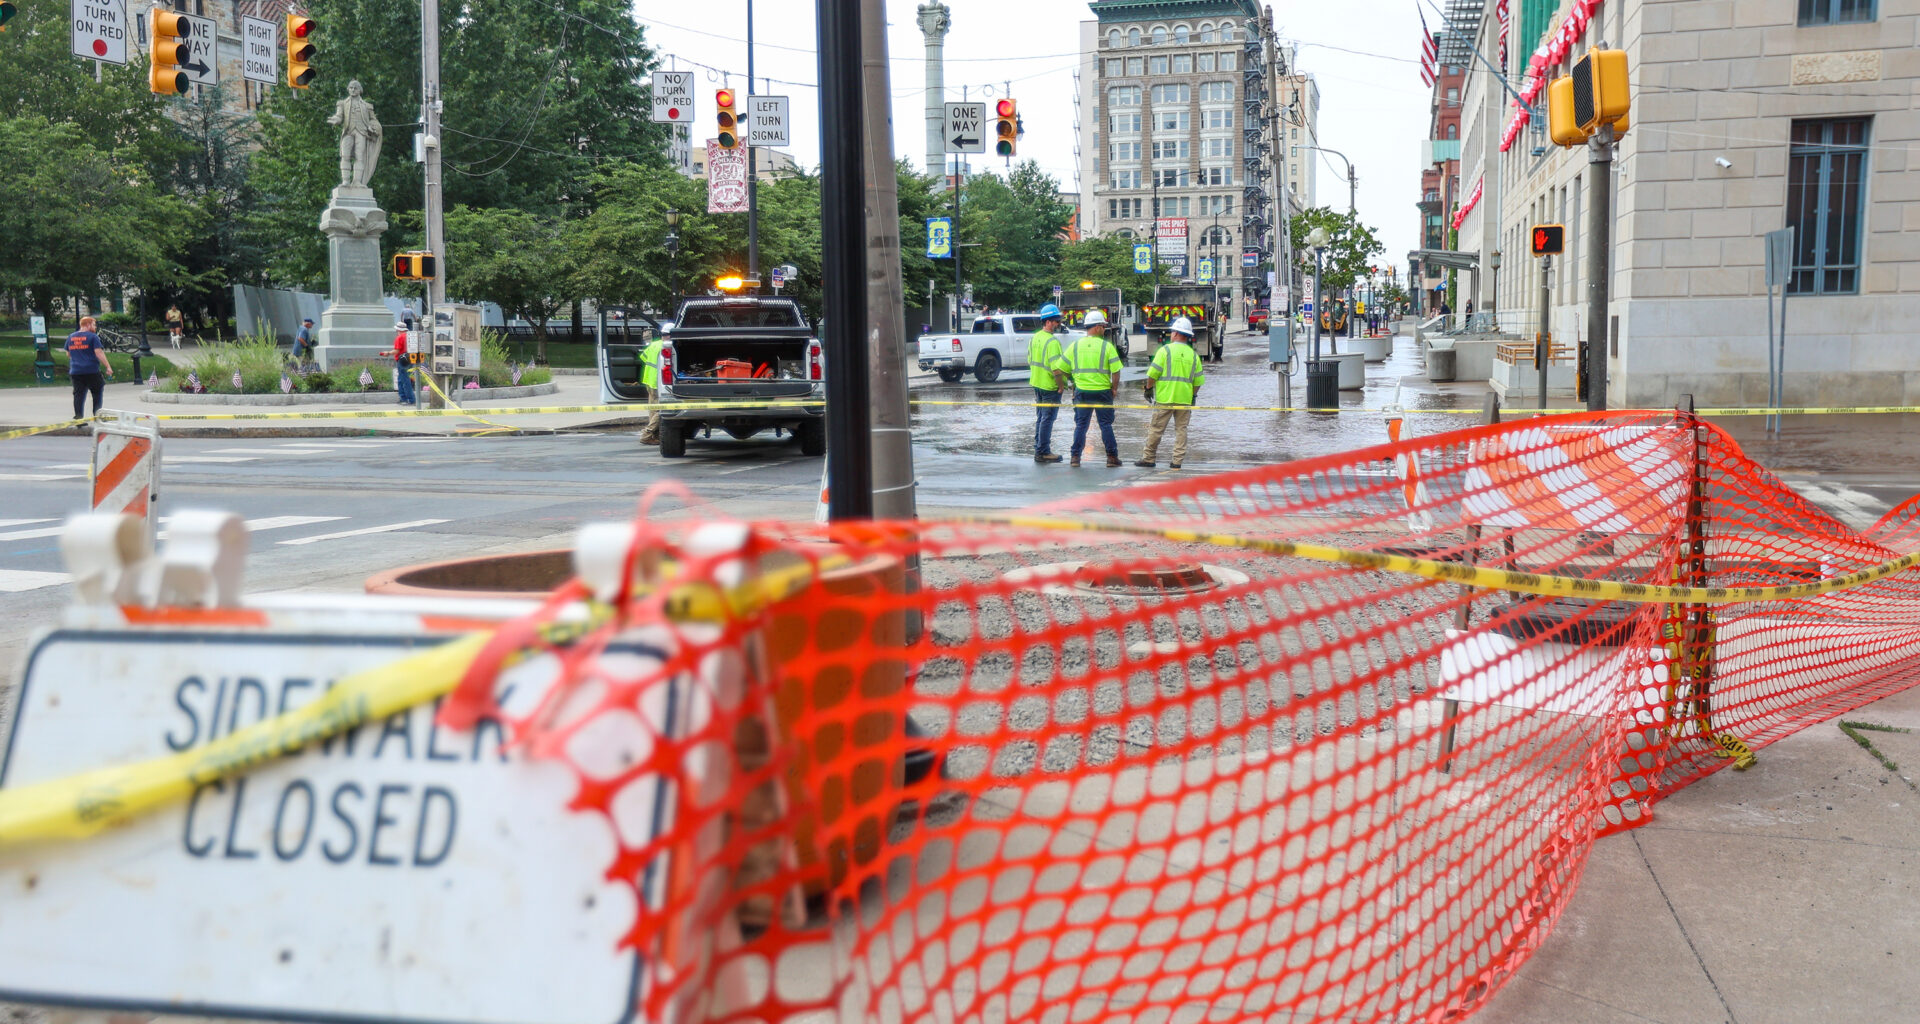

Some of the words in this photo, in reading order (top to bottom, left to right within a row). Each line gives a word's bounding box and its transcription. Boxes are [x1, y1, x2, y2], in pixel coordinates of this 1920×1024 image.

[84, 5, 115, 23] TURN
[76, 19, 93, 34] ON
[100, 24, 123, 40] RED
[193, 22, 209, 39] NE
[248, 24, 271, 41] RIGHT
[183, 38, 210, 56] WAY
[251, 42, 271, 58] TURN
[246, 60, 274, 77] SIGNAL
[664, 74, 682, 84] NO
[662, 86, 685, 95] TURN
[655, 97, 669, 106] ON
[674, 97, 692, 106] RED
[757, 102, 779, 112] LEFT
[953, 107, 977, 119] ONE
[757, 116, 781, 126] TURN
[952, 120, 979, 132] WAY
[752, 131, 786, 141] SIGNAL
[1172, 219, 1186, 228] SPACE
[184, 778, 460, 867] CLOSED
